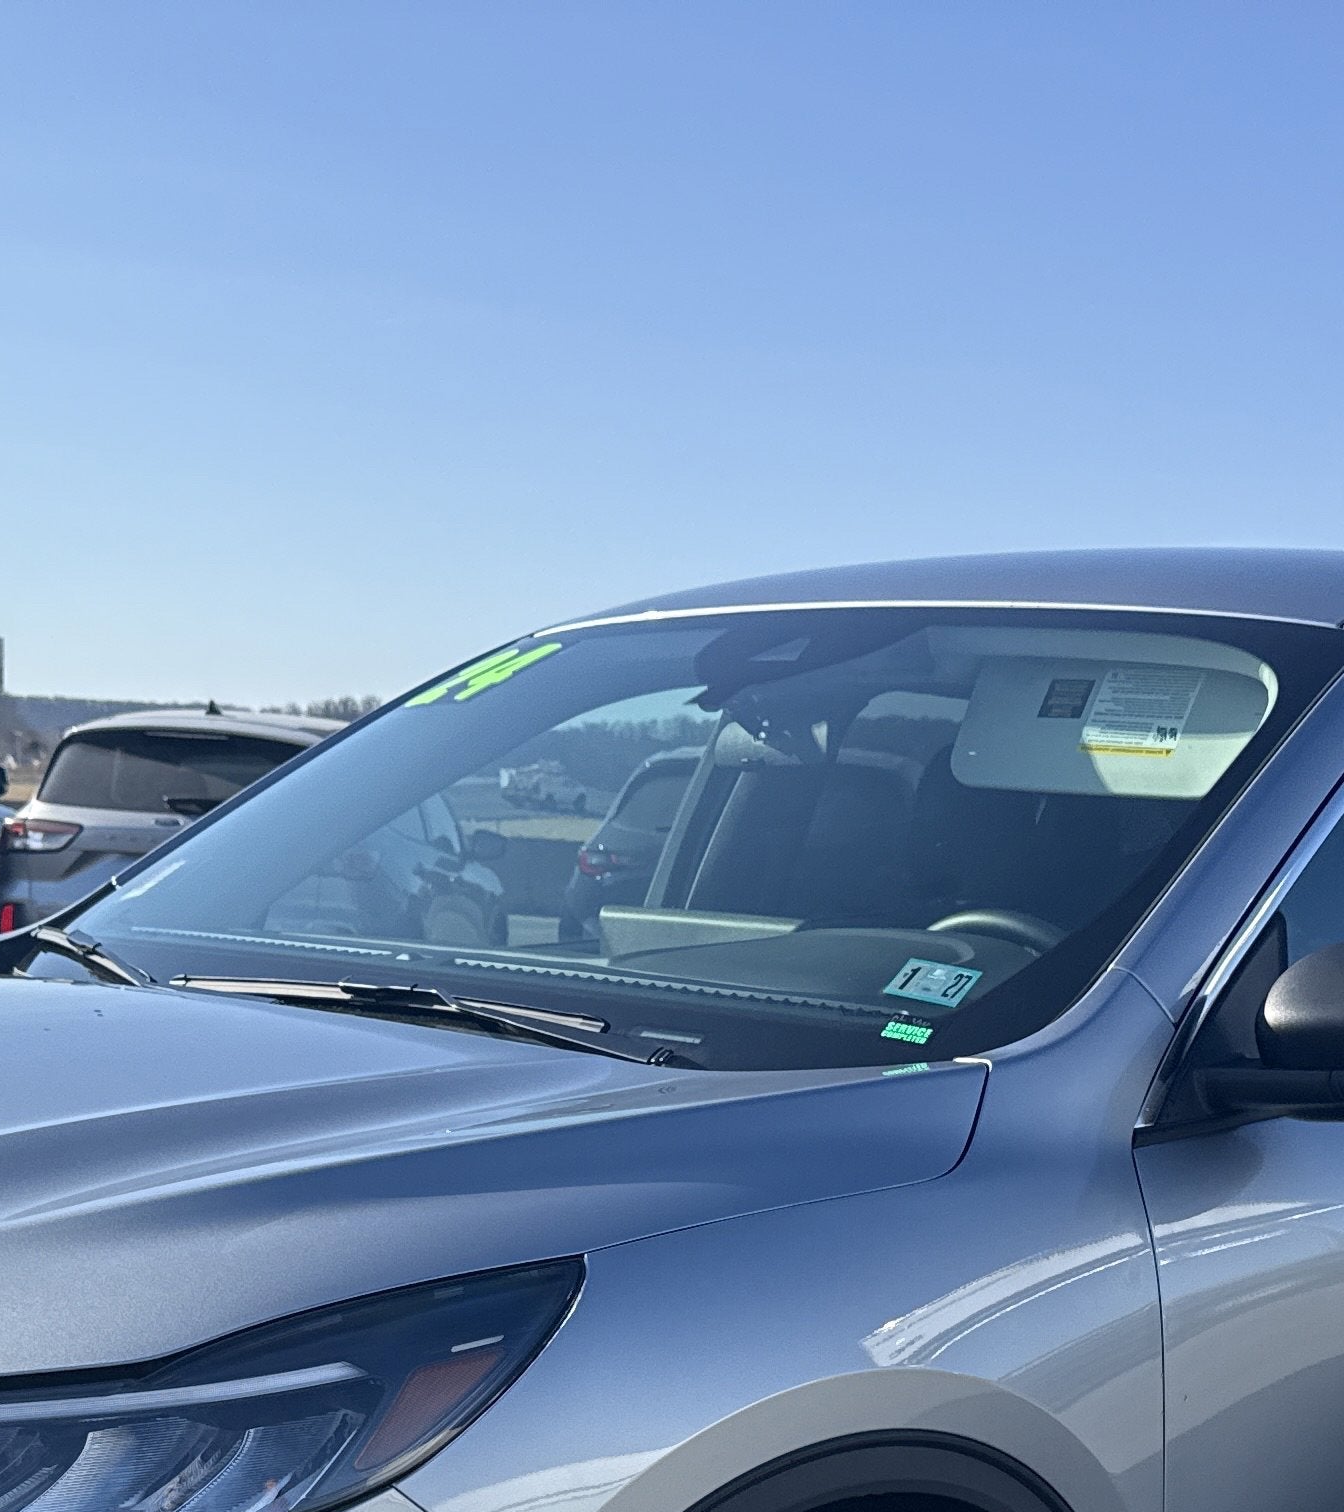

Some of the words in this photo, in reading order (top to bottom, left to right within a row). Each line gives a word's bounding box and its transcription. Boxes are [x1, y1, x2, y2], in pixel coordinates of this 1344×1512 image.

[405, 643, 562, 707] 24
[898, 966, 922, 990] 1
[941, 973, 973, 999] 27
[885, 1021, 933, 1039] SERVICE
